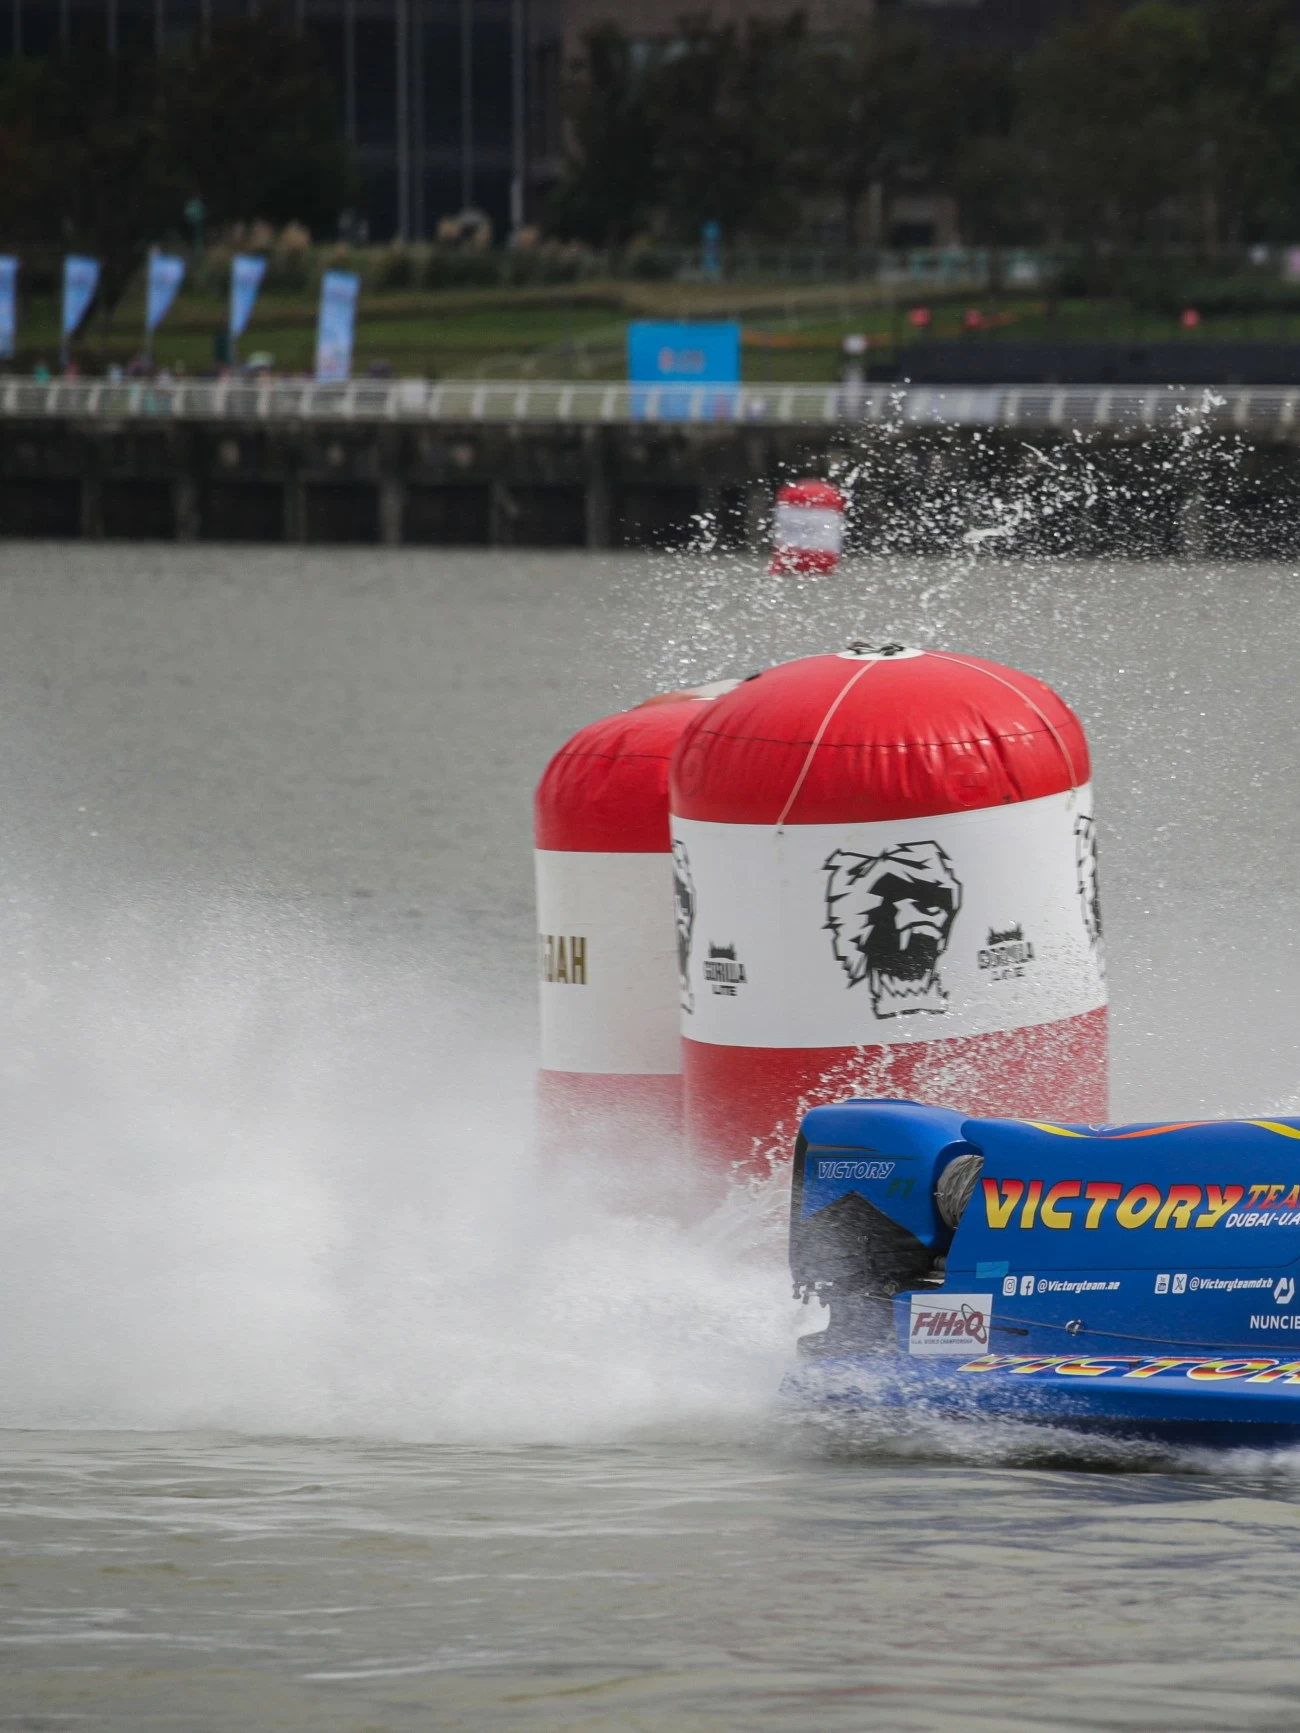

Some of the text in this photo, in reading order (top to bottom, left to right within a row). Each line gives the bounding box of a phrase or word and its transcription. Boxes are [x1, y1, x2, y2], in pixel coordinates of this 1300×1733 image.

[818, 1161, 896, 1179] VICTORY
[981, 1178, 1245, 1230] VICTORY
[1037, 1279, 1121, 1294] @Victoryteam.ae
[1189, 1276, 1274, 1292] @Victoryteamdxb
